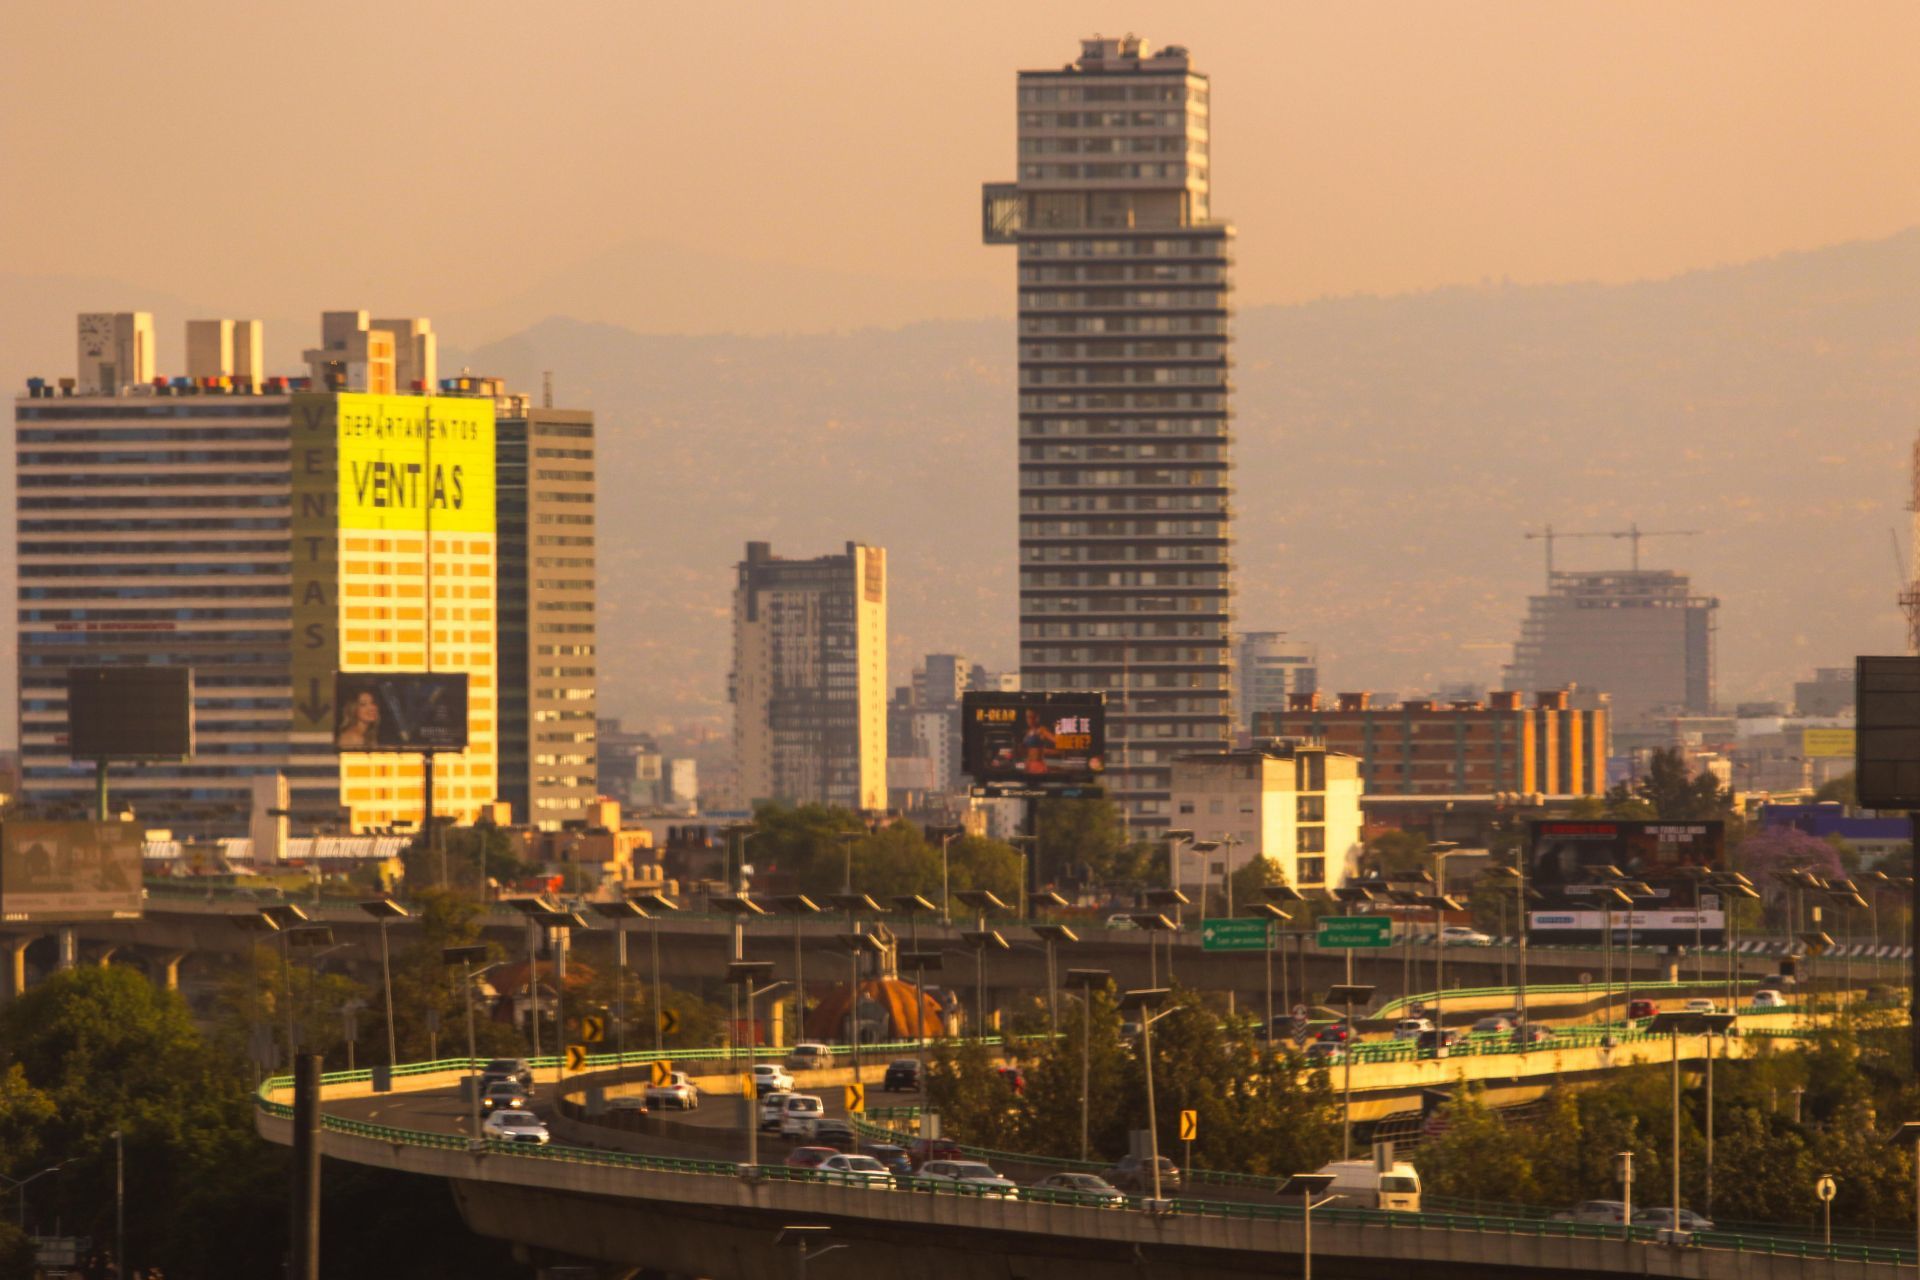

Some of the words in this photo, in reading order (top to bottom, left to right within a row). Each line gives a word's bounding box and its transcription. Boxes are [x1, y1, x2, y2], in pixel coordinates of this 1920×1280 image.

[344, 414, 478, 440] DEPARTAMENTOS
[351, 460, 464, 510] VENTAS
[303, 405, 326, 650] VENTAS
